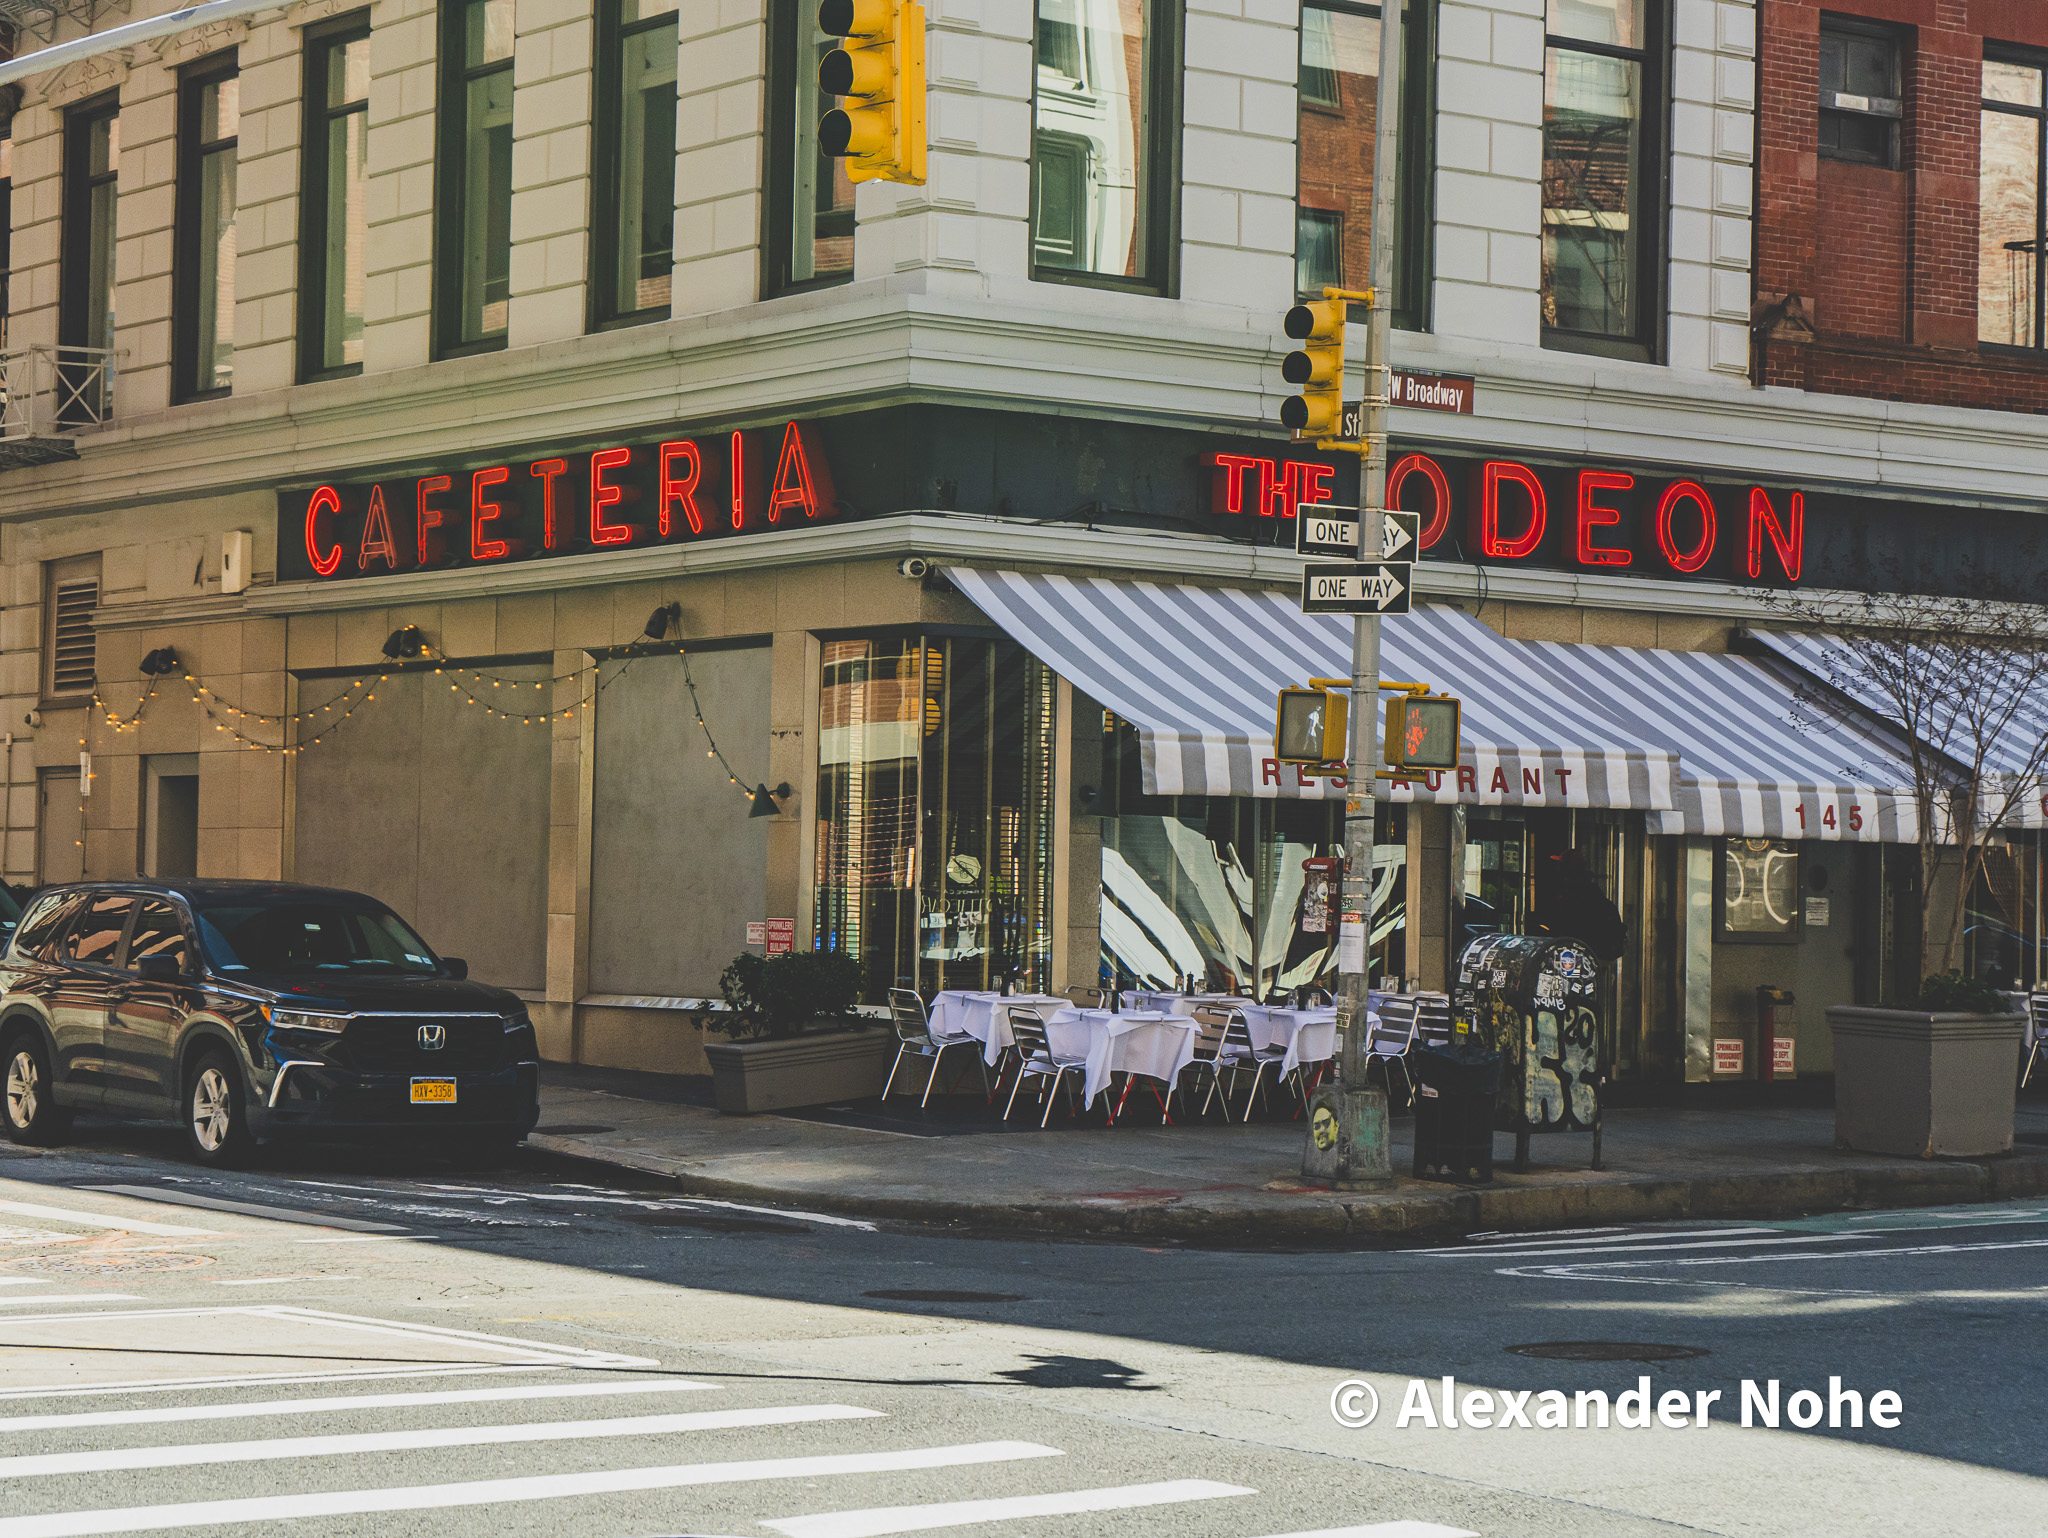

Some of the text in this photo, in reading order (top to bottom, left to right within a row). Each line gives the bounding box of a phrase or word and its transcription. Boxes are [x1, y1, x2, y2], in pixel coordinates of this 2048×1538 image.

[1391, 375, 1464, 413] W Broadway
[1344, 412, 1360, 437] St
[304, 421, 817, 576] CAFETERIA
[1215, 452, 1805, 582] THE ODEON
[1316, 522, 1349, 543] ONE
[1318, 579, 1393, 598] ONE WAY
[1262, 757, 1572, 796] RESAURANT
[1795, 804, 1863, 831] 145
[768, 921, 793, 930] SPRINKLERS
[768, 932, 793, 941] THROUGHOUT
[769, 943, 790, 952] BUILDING
[1716, 1043, 1741, 1051] SPRINKLERS
[1719, 1061, 1738, 1069] BUILDING
